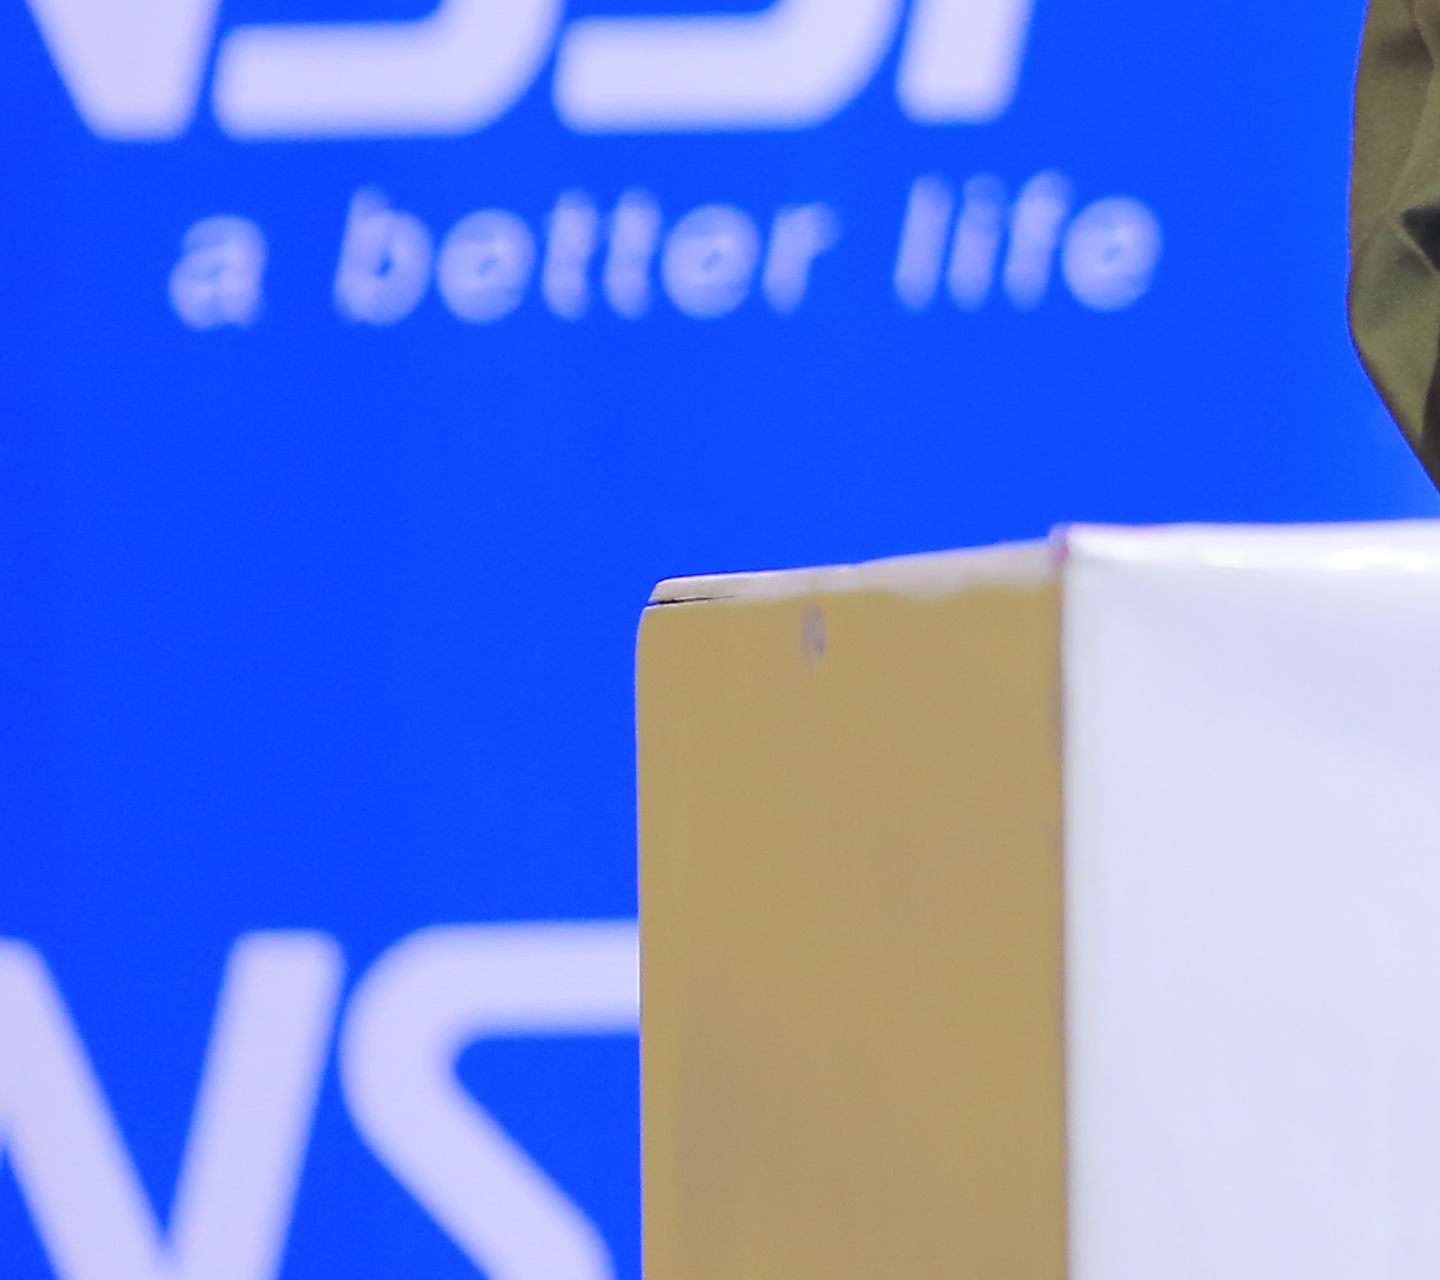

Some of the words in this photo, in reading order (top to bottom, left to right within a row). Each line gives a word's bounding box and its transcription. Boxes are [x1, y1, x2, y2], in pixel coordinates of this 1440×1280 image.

[169, 213, 265, 328] a
[332, 186, 838, 328] better
[895, 172, 1161, 315] life
